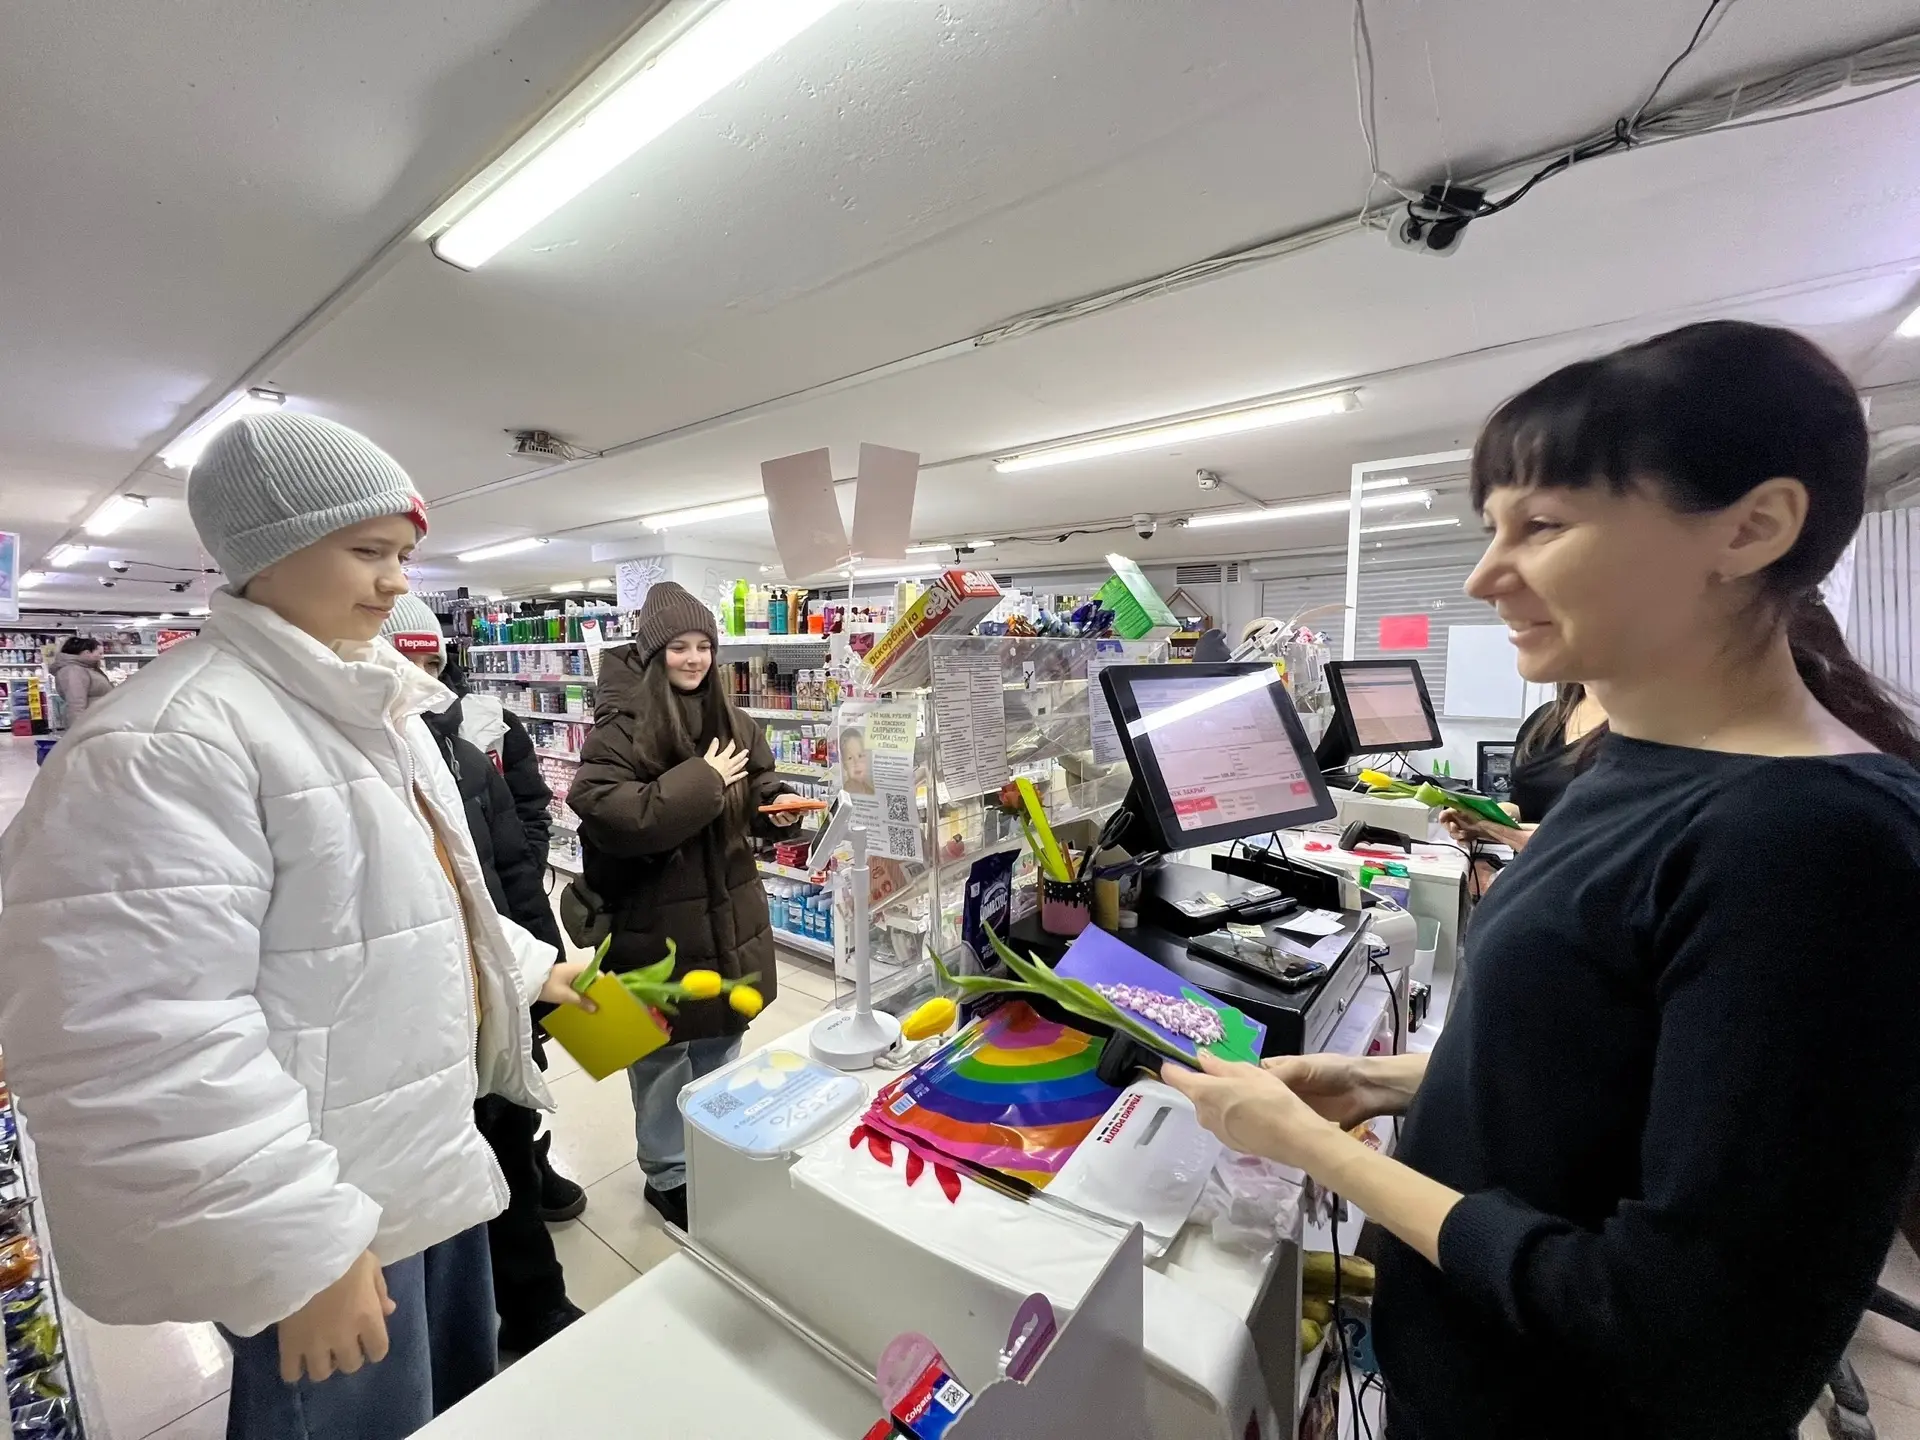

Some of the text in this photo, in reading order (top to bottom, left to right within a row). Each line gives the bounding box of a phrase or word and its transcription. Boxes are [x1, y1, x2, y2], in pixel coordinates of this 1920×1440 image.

[398, 638, 438, 650] Первые
[869, 611, 919, 665] аскорбинка
[904, 1392, 932, 1423] Colgate
